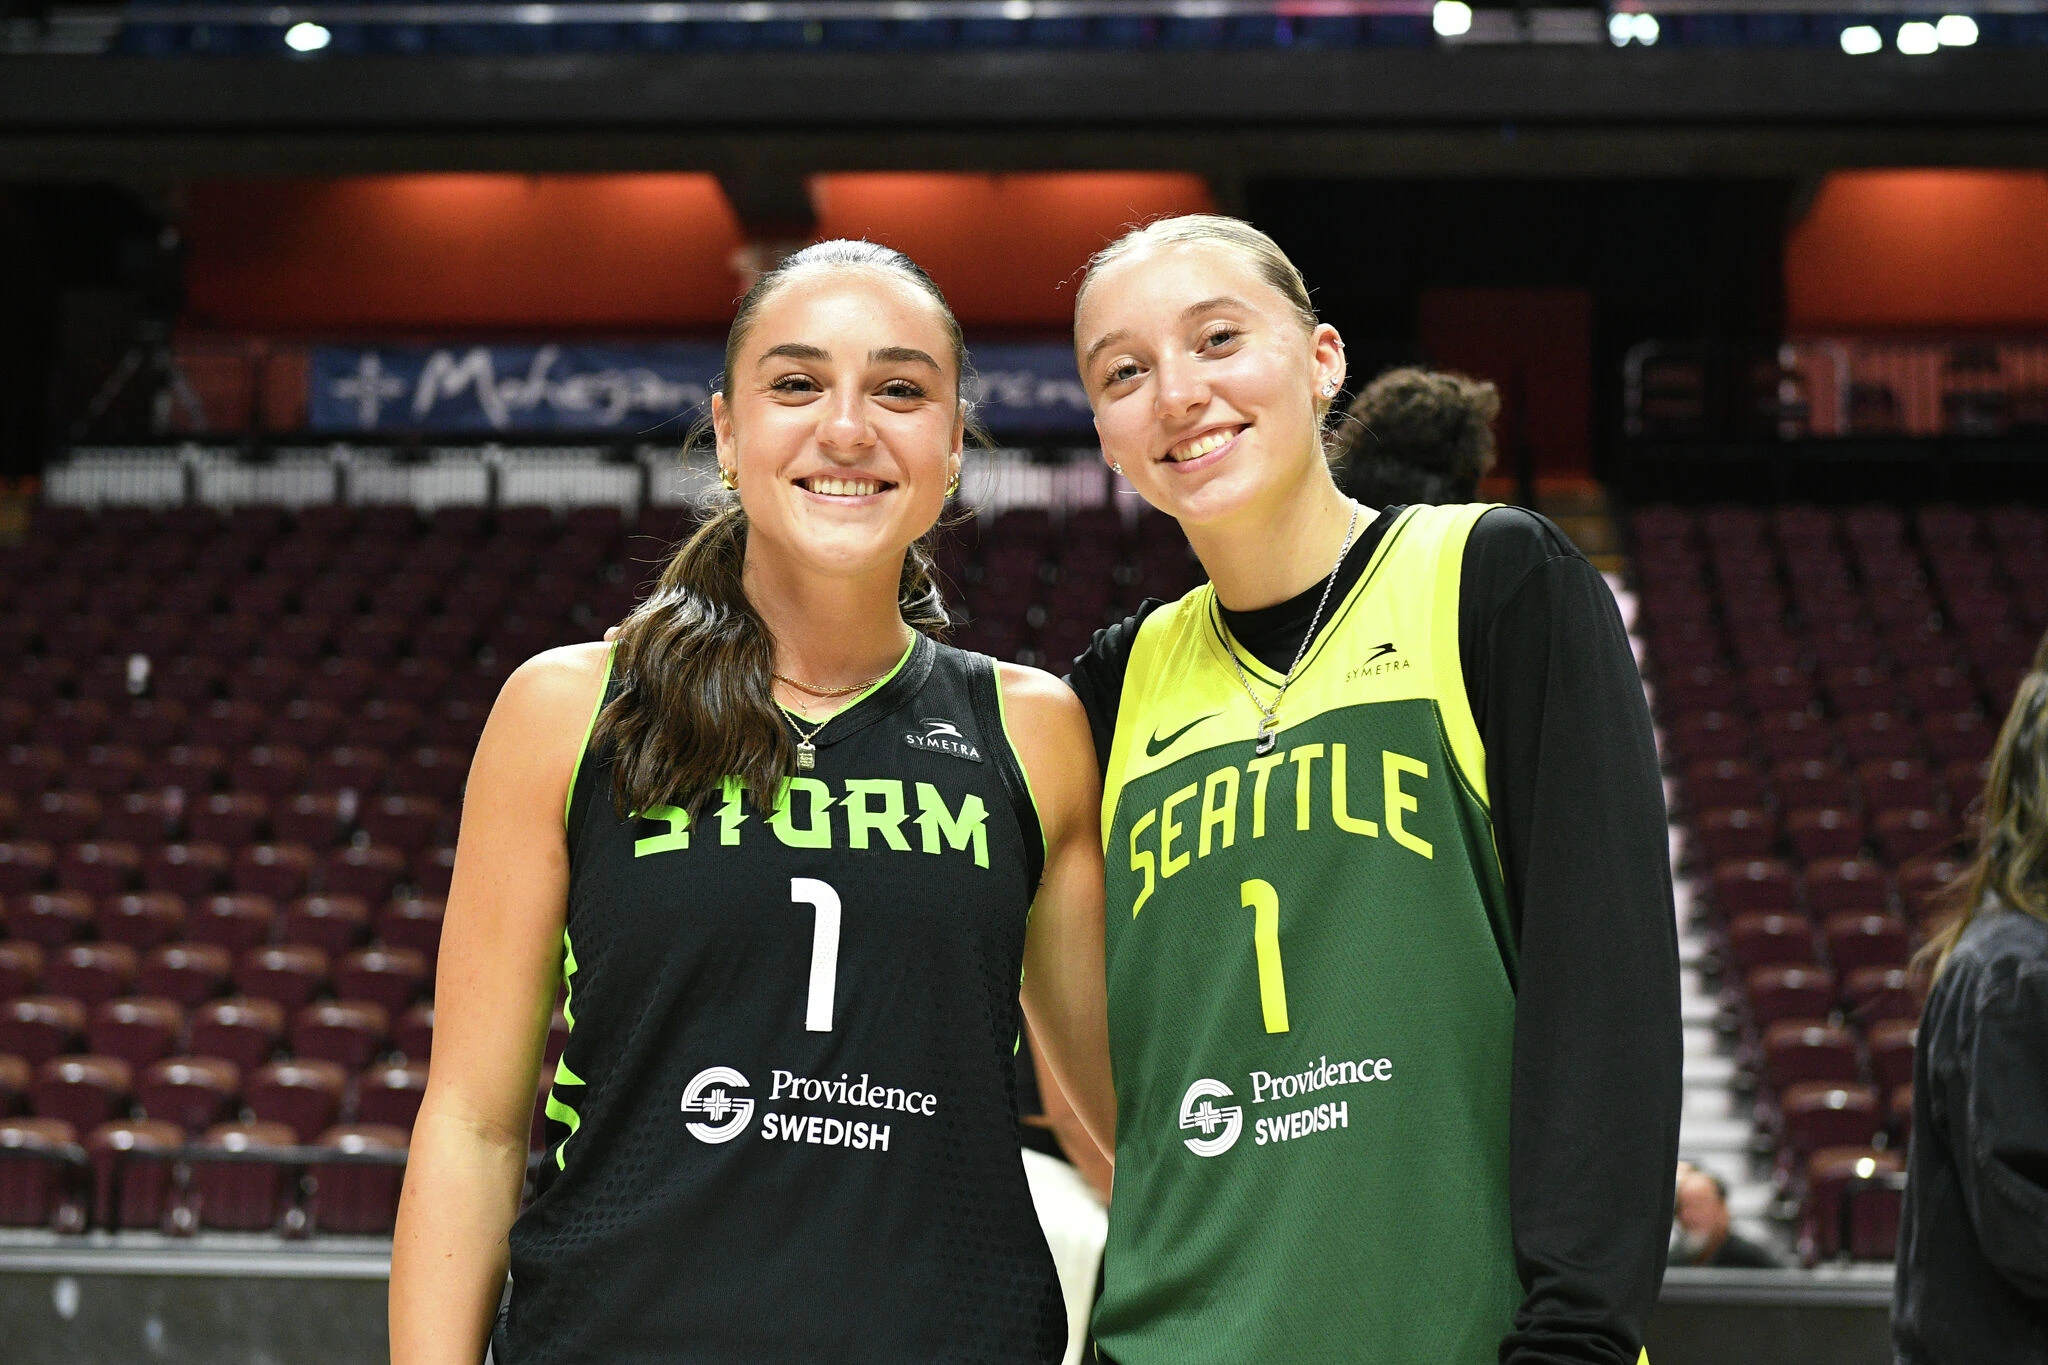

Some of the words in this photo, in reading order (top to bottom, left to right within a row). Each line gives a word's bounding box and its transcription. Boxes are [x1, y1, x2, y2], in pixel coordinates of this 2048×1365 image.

[1345, 659, 1411, 683] SYMETRA
[906, 734, 980, 758] SYMETRA
[1129, 743, 1434, 920] SEATTLE
[790, 877, 842, 1032] 1
[1240, 878, 1290, 1034] 1
[768, 1069, 938, 1117] Providence
[1249, 1055, 1393, 1104] Providence
[760, 1112, 891, 1152] SWEDISH
[1254, 1100, 1349, 1146] SWEDISH
